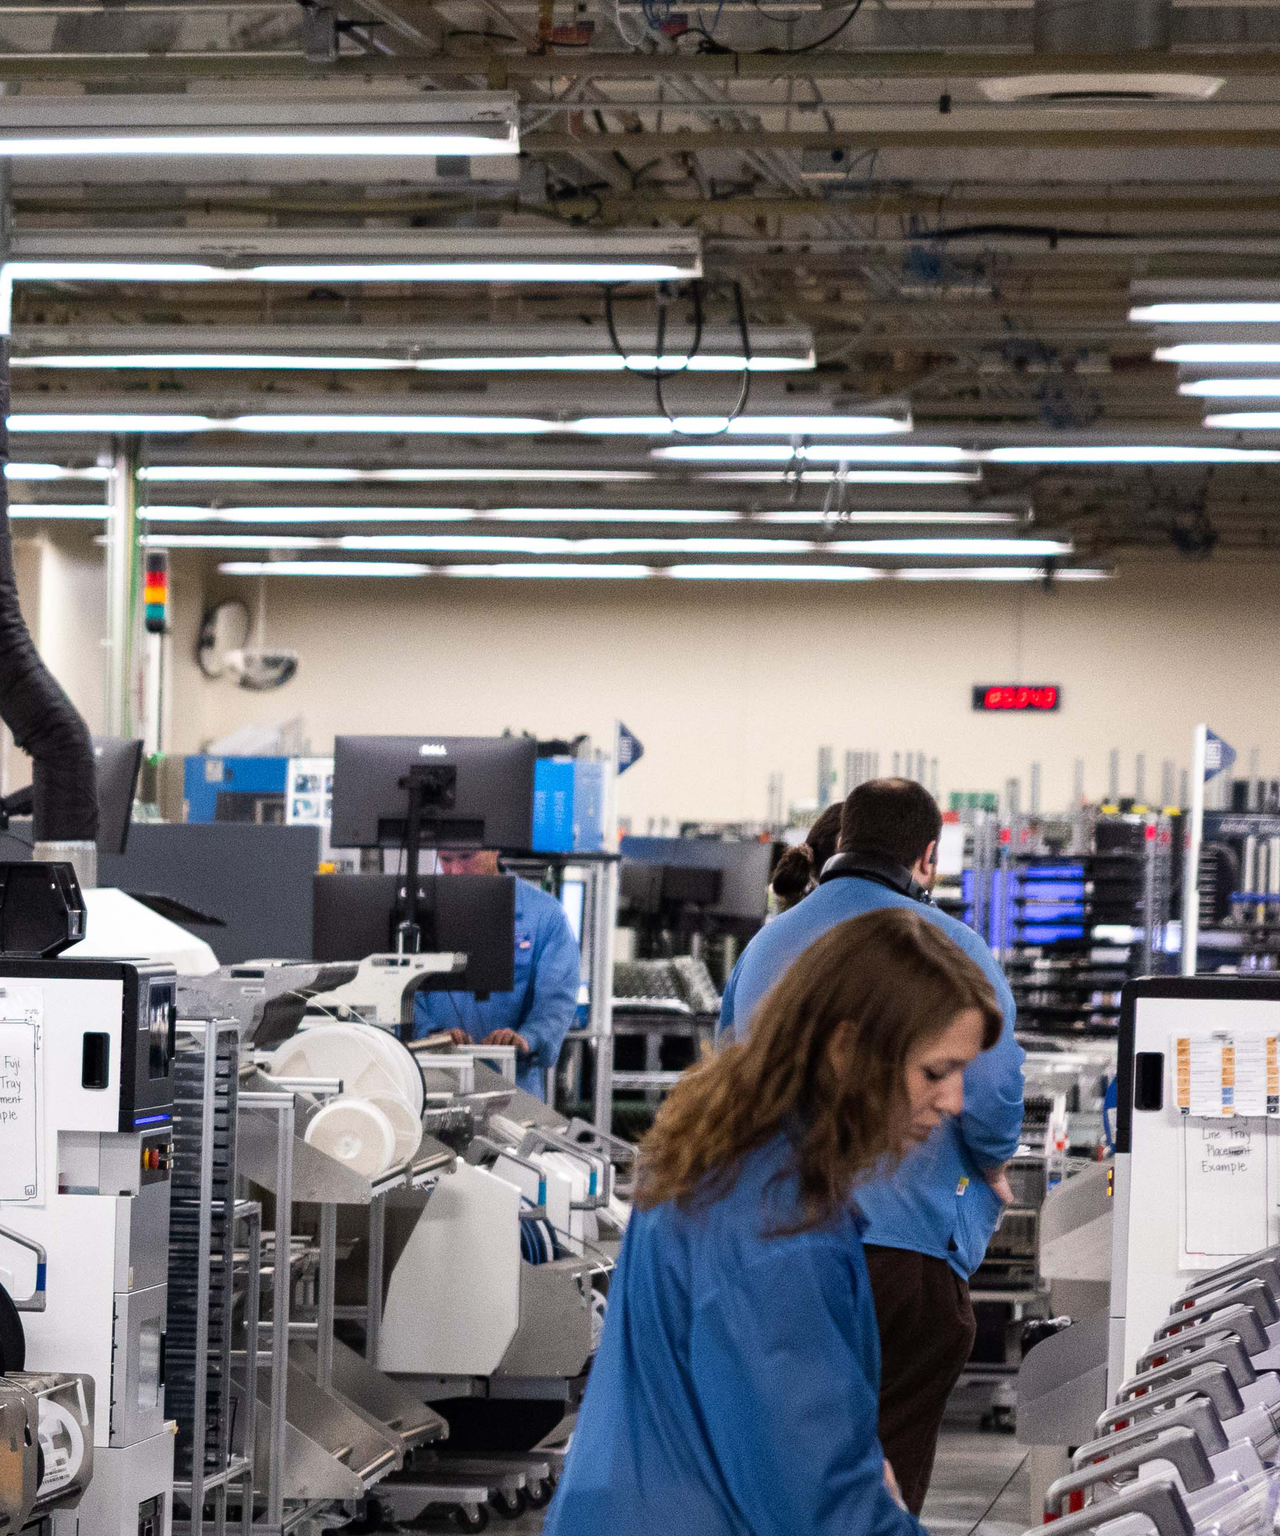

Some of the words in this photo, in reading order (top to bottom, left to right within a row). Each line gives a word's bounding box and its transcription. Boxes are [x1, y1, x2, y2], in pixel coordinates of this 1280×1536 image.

[5, 1055, 21, 1076] Fuji
[0, 1075, 21, 1094] Tray
[1202, 1127, 1221, 1140] Line
[1227, 1126, 1251, 1144] Tray
[1201, 1160, 1248, 1175] Example
